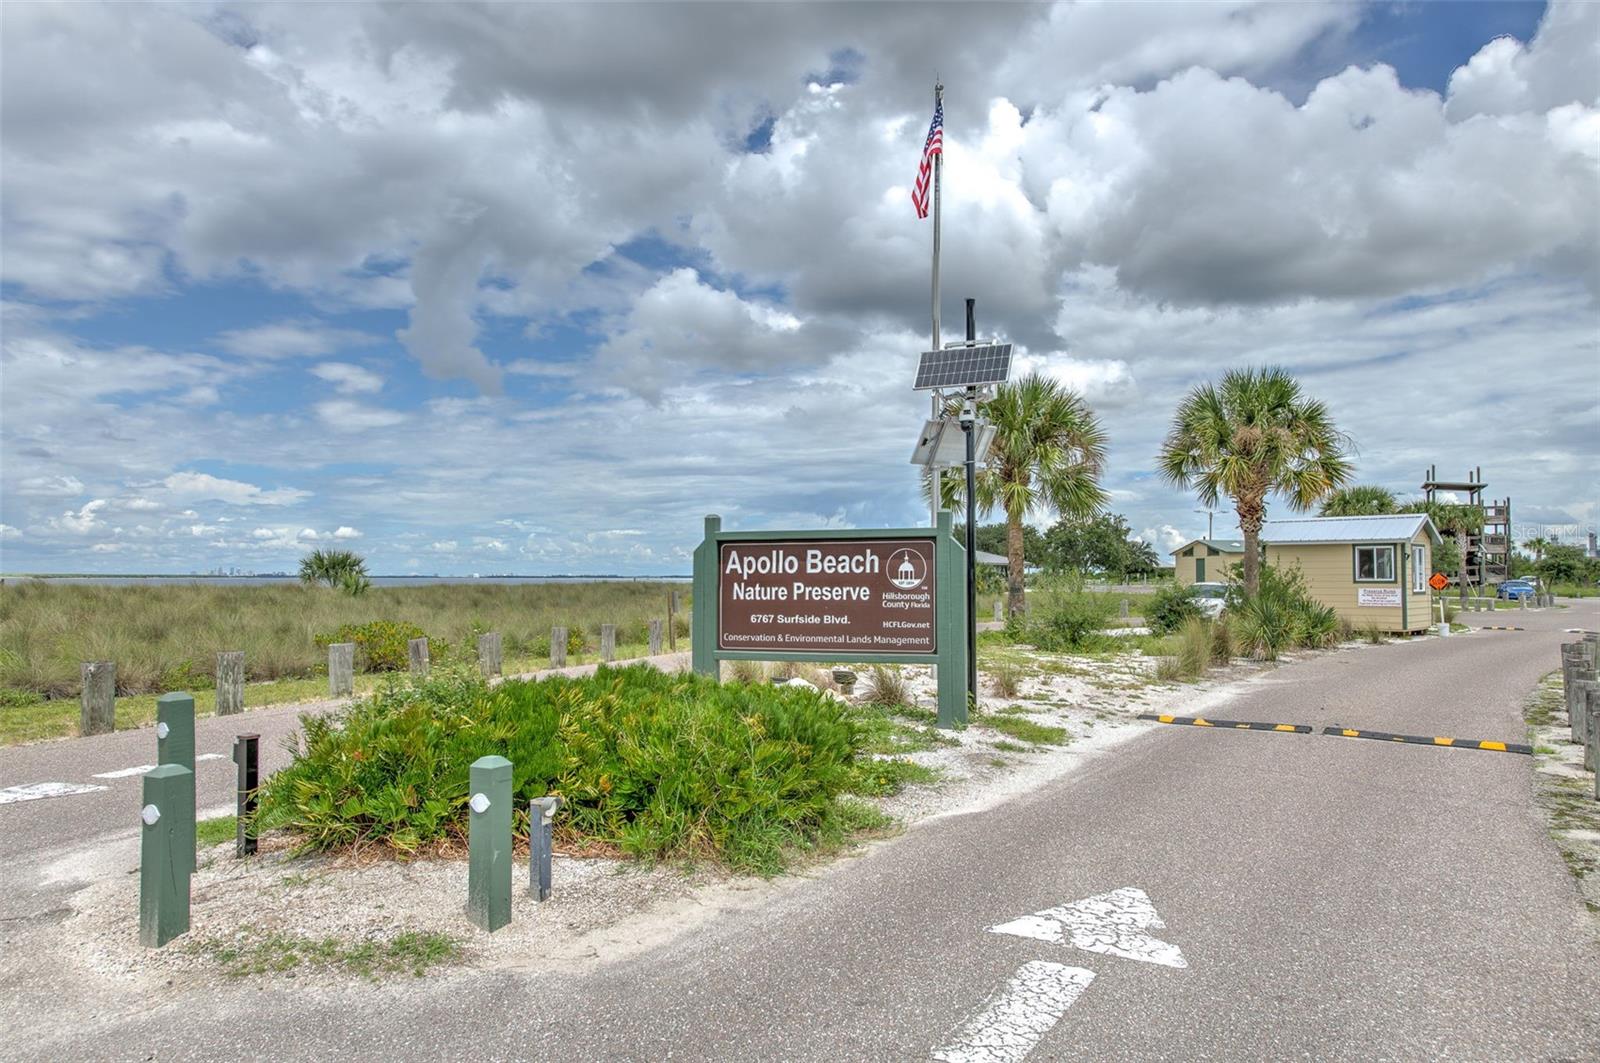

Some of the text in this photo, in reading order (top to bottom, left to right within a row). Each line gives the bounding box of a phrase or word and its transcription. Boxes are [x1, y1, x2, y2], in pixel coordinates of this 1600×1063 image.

[725, 548, 880, 580] Apollo Beach
[732, 582, 870, 601] Nature Preserve
[882, 592, 930, 602] Hillsborough
[882, 600, 909, 610] County
[750, 614, 851, 625] 6767 Surfside Blvd.
[882, 621, 930, 629] HCFLGov.net
[723, 632, 930, 646] Conservation & Environmental Lands Management
